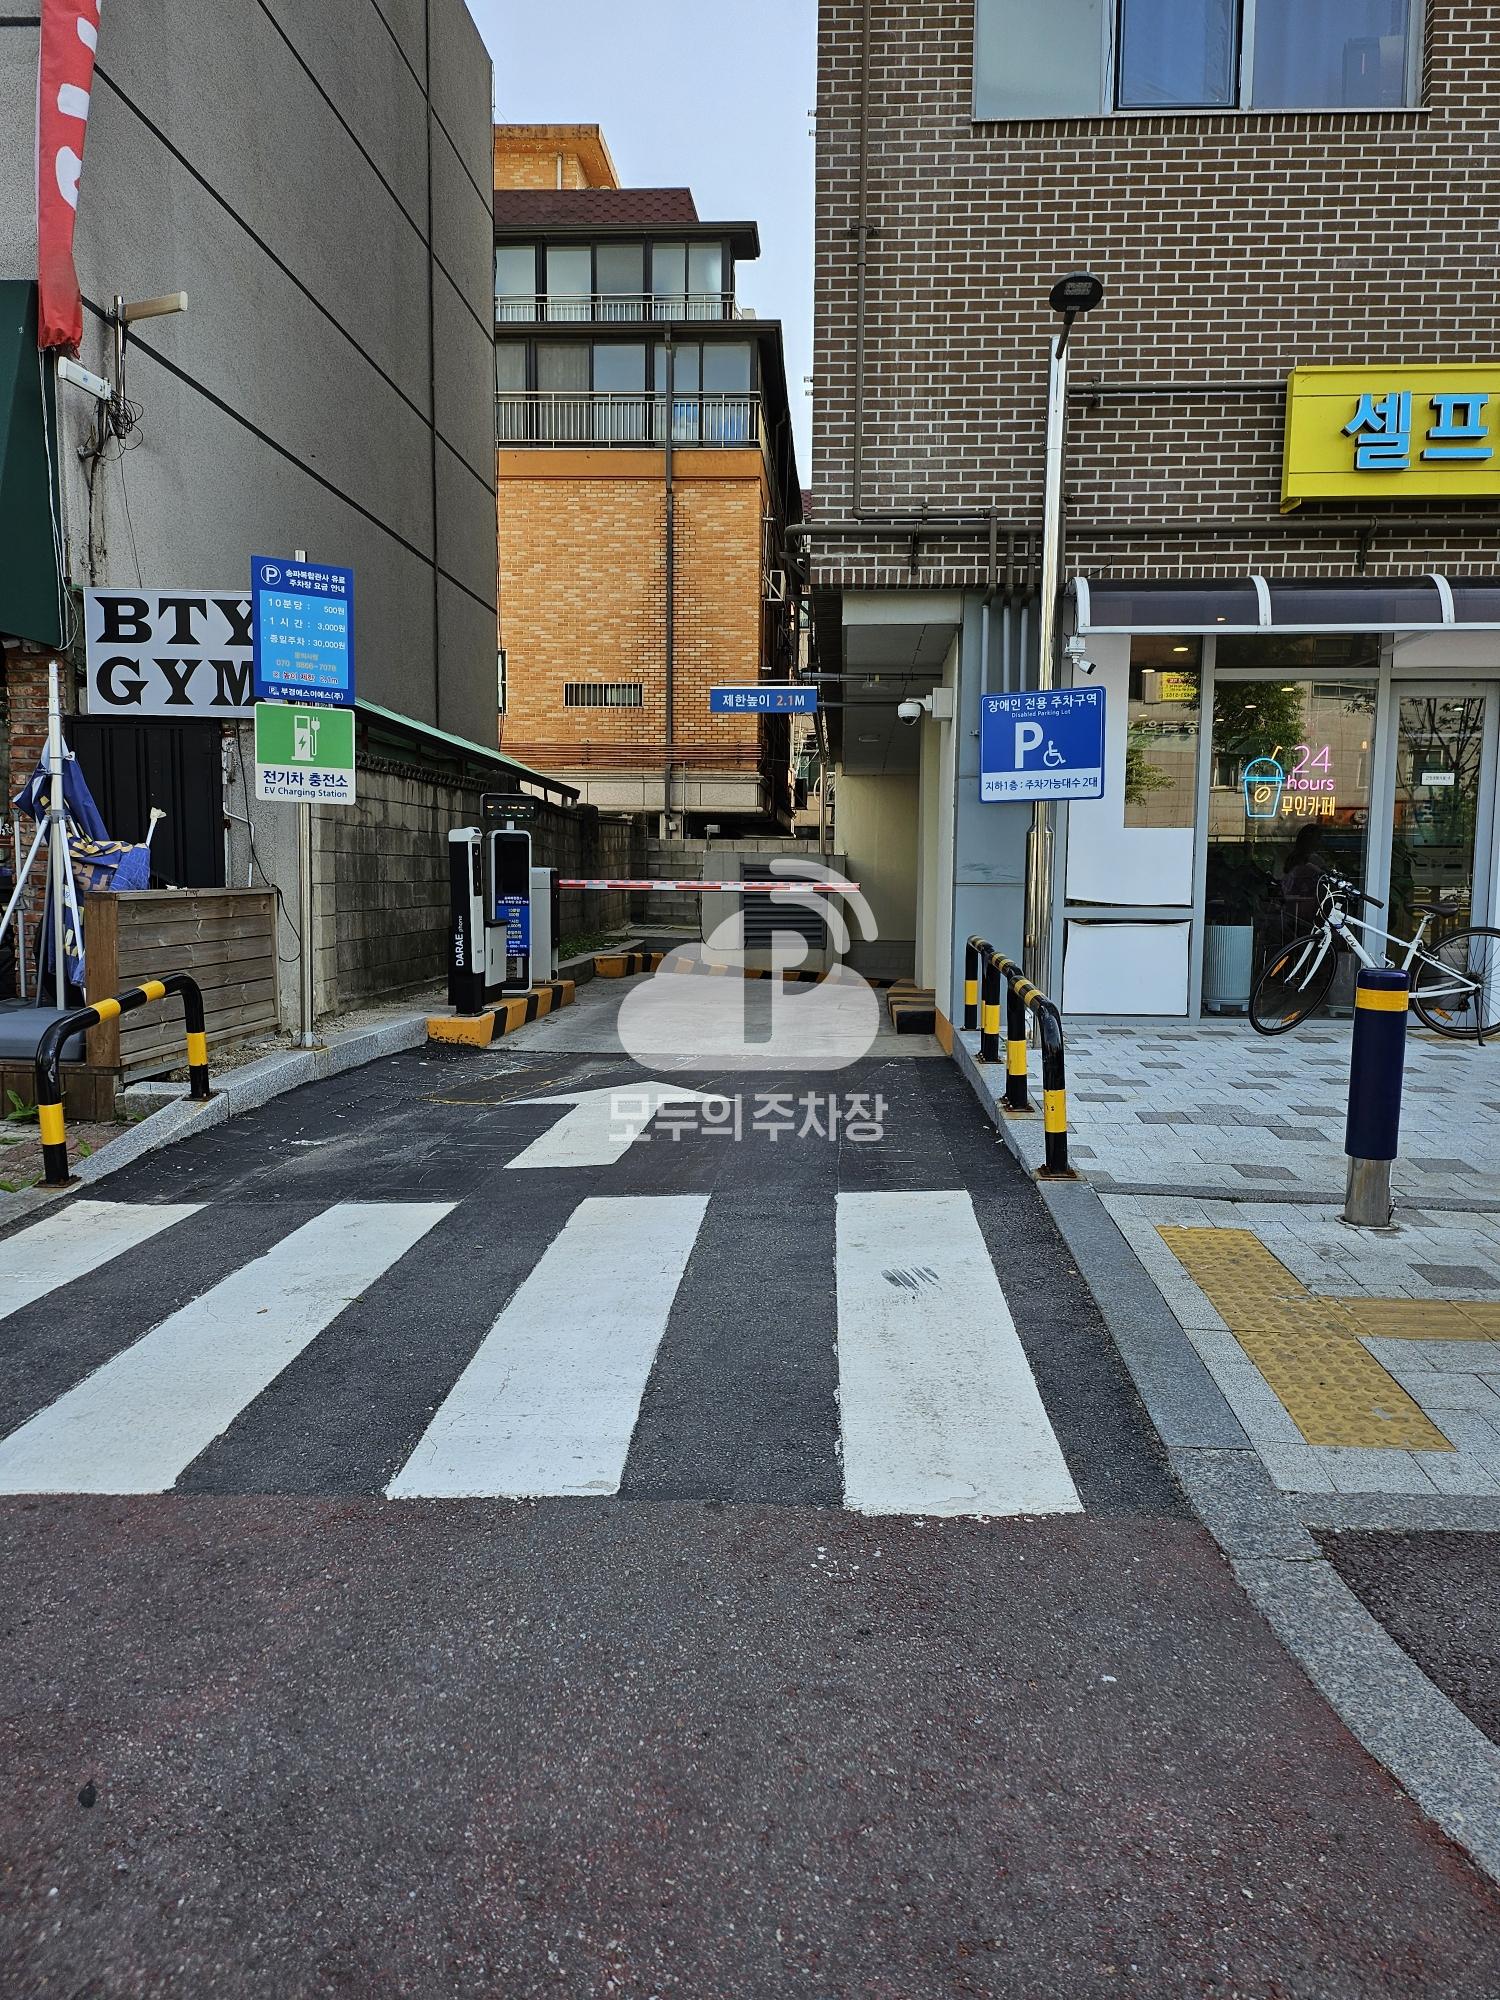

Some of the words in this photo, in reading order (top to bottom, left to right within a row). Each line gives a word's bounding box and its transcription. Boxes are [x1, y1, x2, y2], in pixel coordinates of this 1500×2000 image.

[289, 579, 312, 589] 주차장
[314, 582, 329, 591] 요금
[330, 584, 345, 594] 안내
[323, 606, 345, 616] 500원
[93, 596, 254, 646] BTY
[96, 656, 264, 706] GYM
[722, 694, 770, 707] 제한높이
[776, 695, 805, 707] 2.1M
[988, 698, 1021, 713] 장애인
[1024, 696, 1047, 710] 전용
[1050, 692, 1097, 709] 주차구역
[1015, 721, 1044, 769] P
[1292, 745, 1332, 773] 24
[263, 770, 304, 786] 전기차
[309, 772, 348, 788] 충전소
[985, 780, 1018, 792] 지하1층
[1025, 777, 1081, 790] 주차가능대수
[1082, 777, 1098, 788] 2대
[1286, 775, 1335, 791] hours
[264, 786, 275, 794] EV
[278, 786, 316, 798] Charging
[318, 789, 347, 798] Station
[1281, 795, 1336, 817] 무인카페
[455, 933, 464, 967] DARAE
